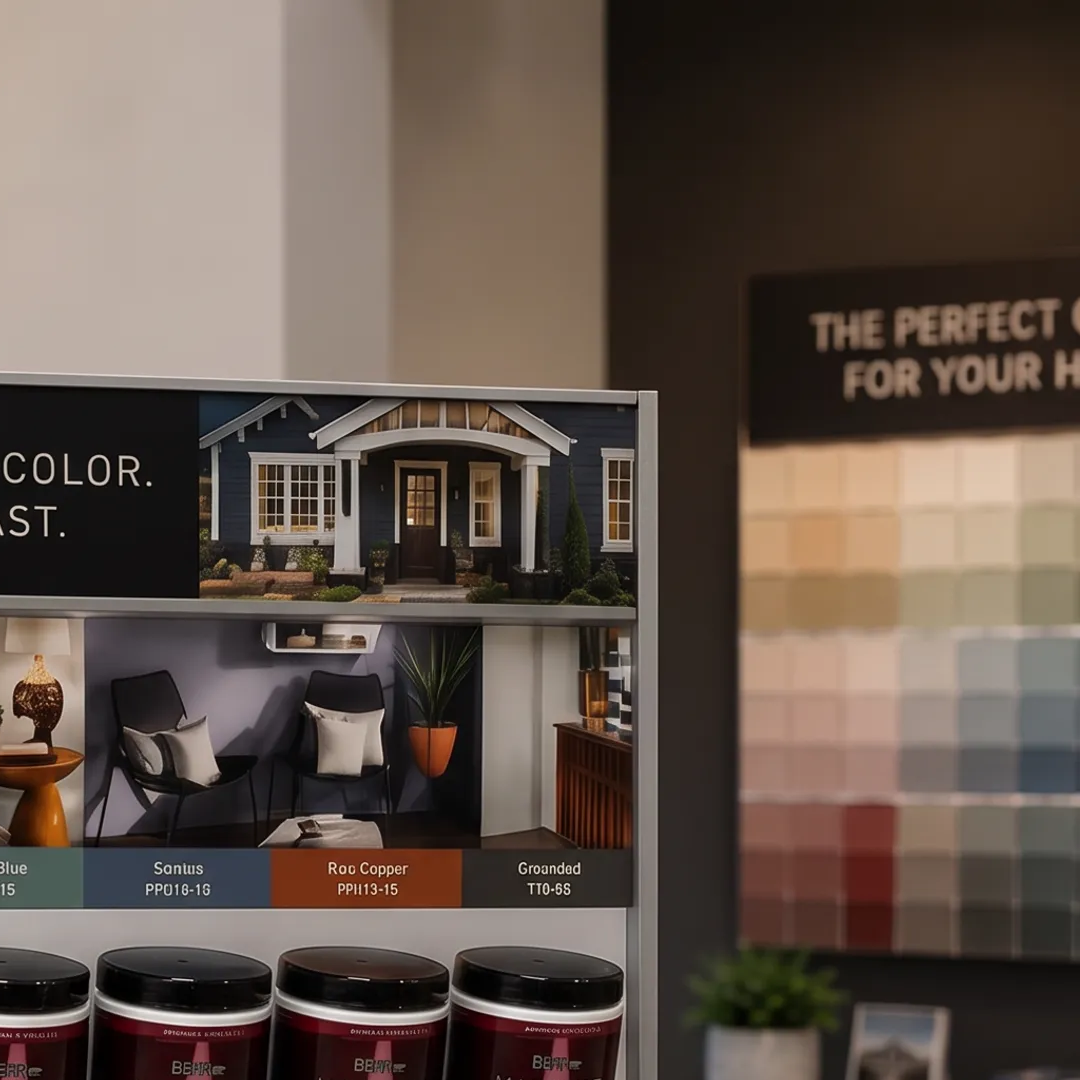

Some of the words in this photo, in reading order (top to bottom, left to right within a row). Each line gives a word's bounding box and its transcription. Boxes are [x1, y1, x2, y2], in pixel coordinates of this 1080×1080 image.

[810, 308, 885, 352] THE
[894, 298, 1062, 348] PERFECT
[843, 356, 922, 401] FOR
[929, 351, 1042, 395] YOUR
[2, 452, 153, 487] COLOR.
[360, 861, 409, 878] Copper
